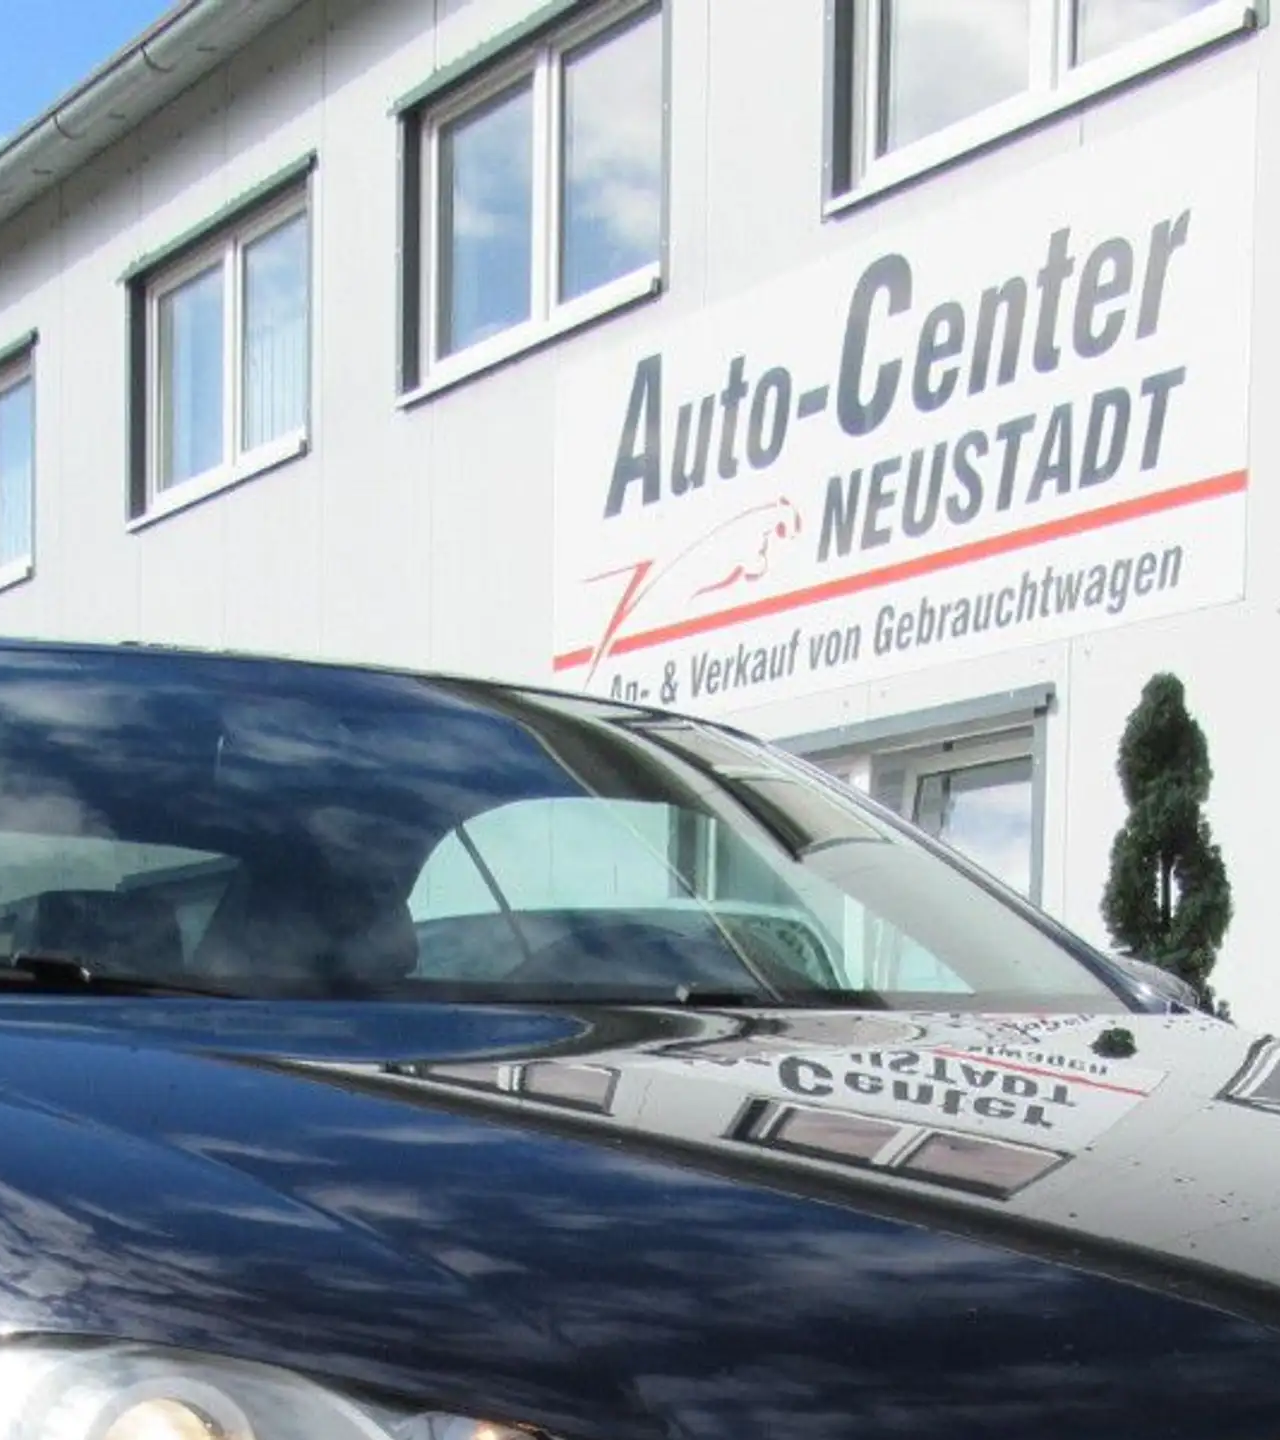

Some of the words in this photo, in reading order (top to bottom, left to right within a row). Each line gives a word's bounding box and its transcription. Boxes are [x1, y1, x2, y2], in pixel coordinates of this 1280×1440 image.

[604, 208, 1191, 519] Auto-Center
[818, 366, 1187, 564] NEUSTADT
[611, 674, 651, 701] An-
[660, 660, 679, 704] &
[691, 634, 801, 698] Verkauf
[809, 623, 861, 666] von
[875, 545, 1184, 650] Gebrauchtwagen
